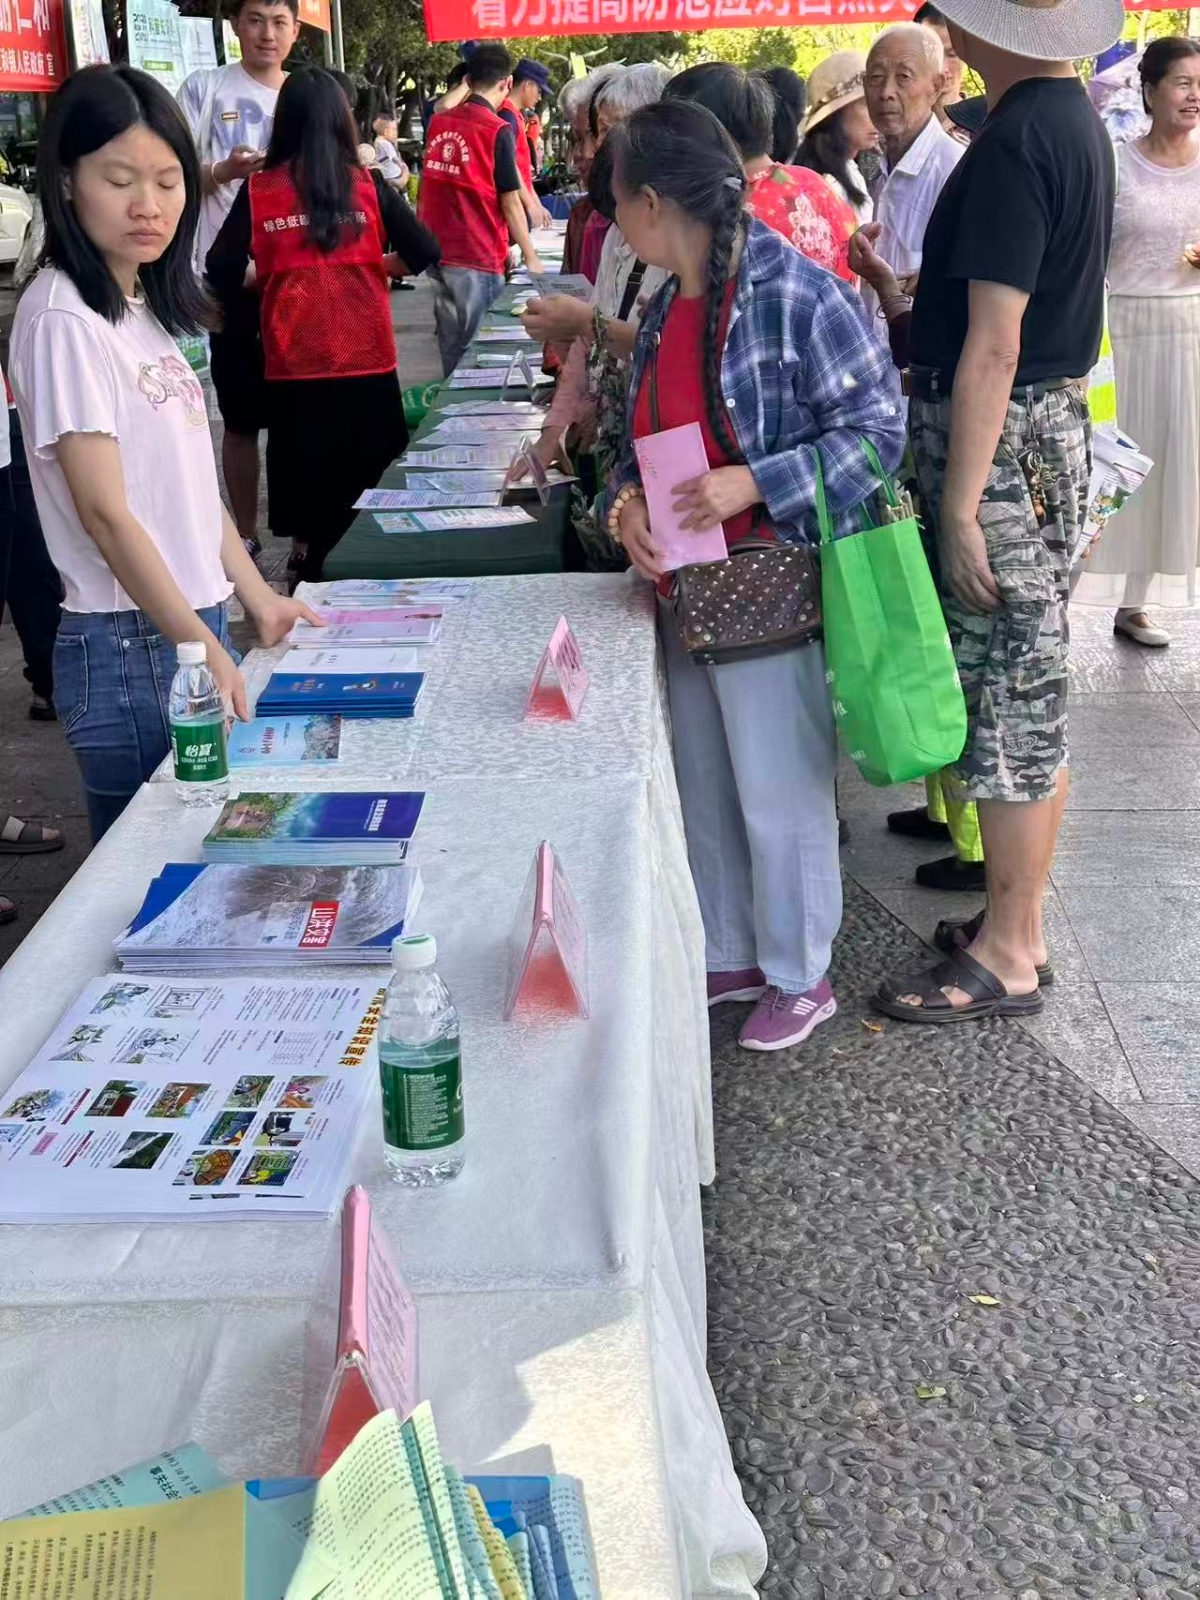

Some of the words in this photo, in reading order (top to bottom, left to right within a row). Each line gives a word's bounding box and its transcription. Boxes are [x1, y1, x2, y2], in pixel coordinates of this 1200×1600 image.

[302, 907, 336, 944] 山洪灾害
[150, 1466, 183, 1500] 事关社会
